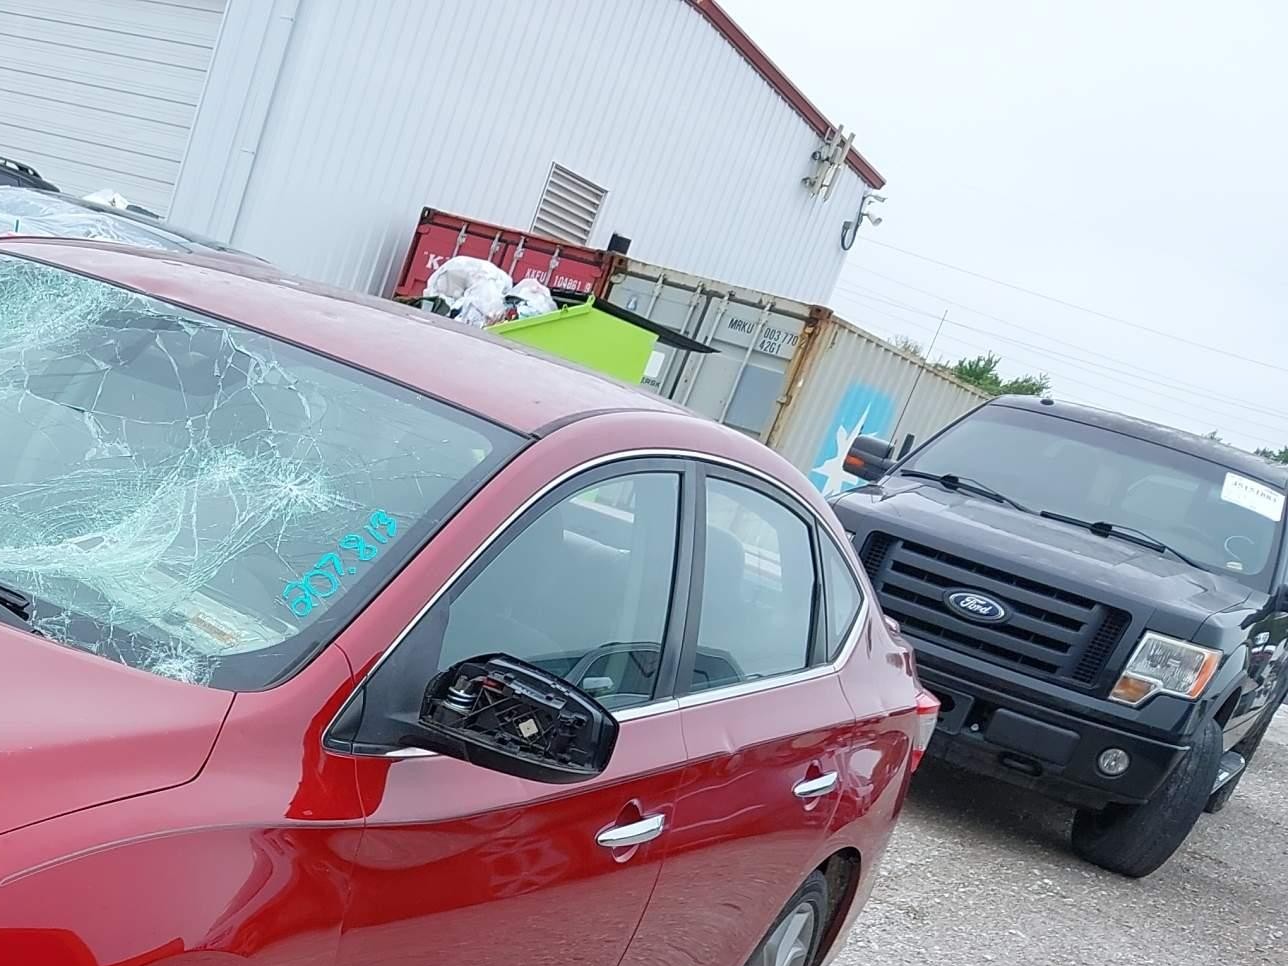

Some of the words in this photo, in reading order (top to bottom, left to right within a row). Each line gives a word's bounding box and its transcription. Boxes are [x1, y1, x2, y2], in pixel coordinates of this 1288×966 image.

[728, 318, 754, 334] MRKU
[759, 339, 782, 354] 42G1
[959, 596, 993, 615] Ford
